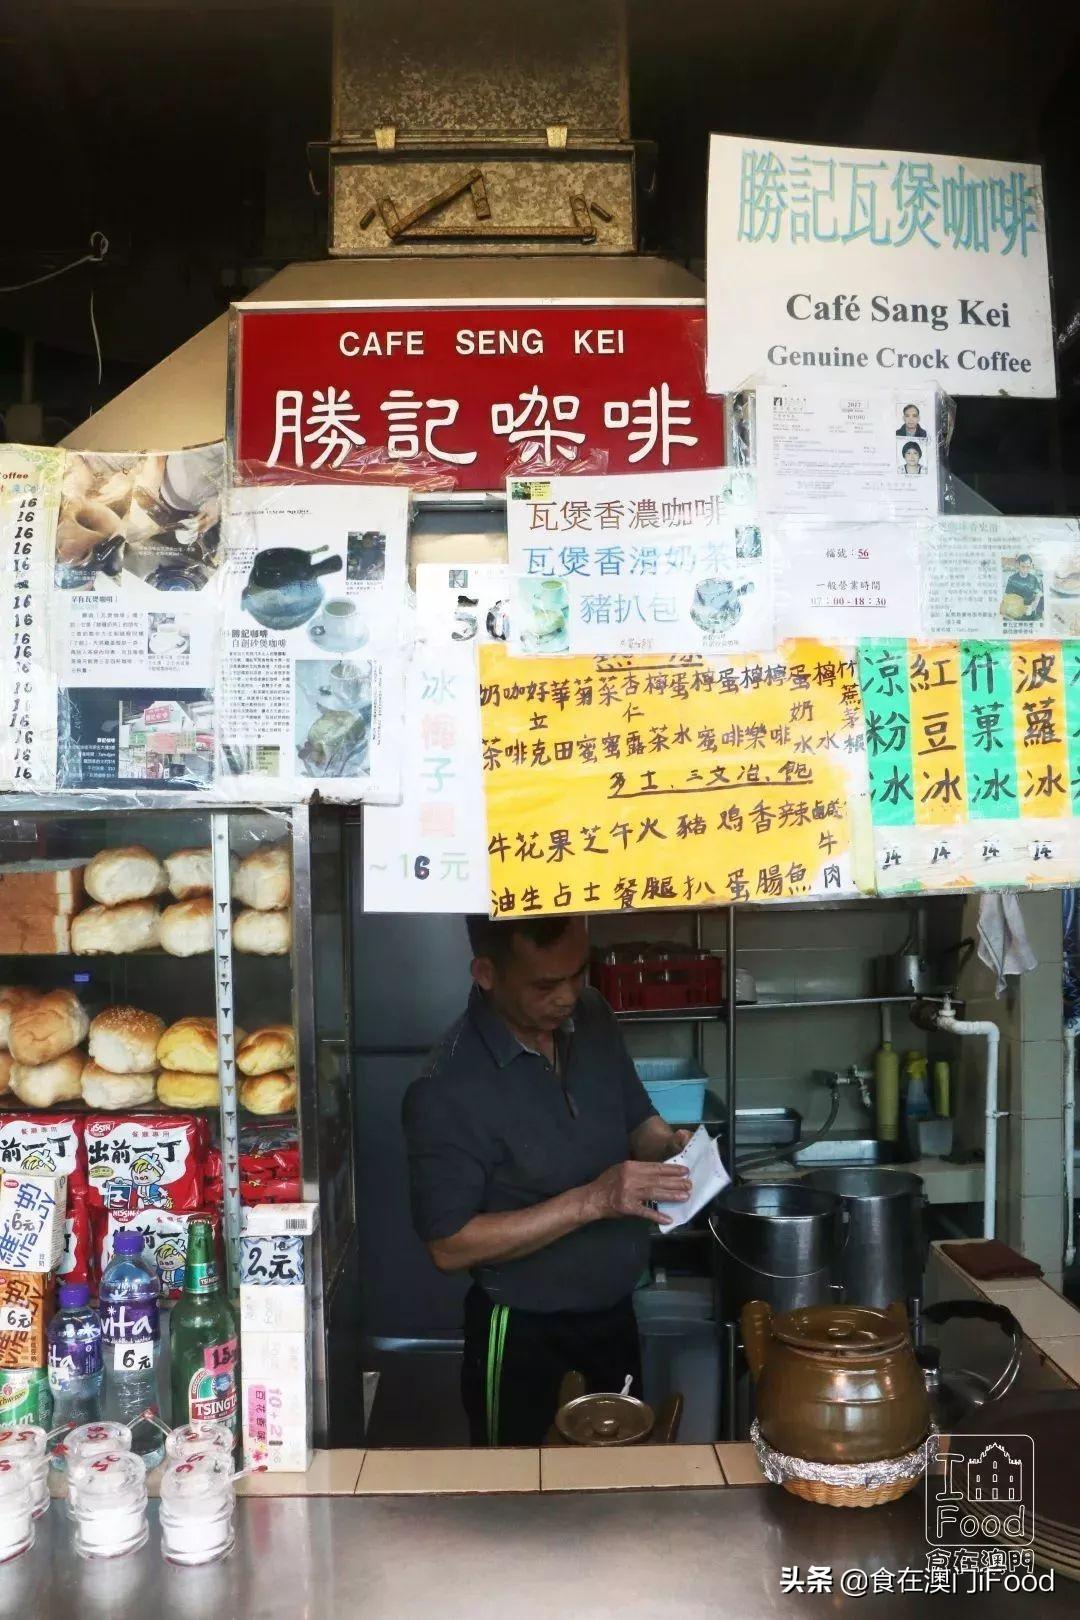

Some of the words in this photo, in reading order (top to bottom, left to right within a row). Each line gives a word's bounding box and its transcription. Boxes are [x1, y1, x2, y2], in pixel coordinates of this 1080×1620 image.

[737, 150, 1038, 257] 勝記瓦煲咖啡
[786, 293, 861, 321] Café
[872, 295, 948, 331] Sang
[958, 298, 1011, 328] Kei
[339, 331, 425, 356] CAFE
[455, 329, 545, 355] SENG
[574, 329, 625, 354] KEI
[767, 345, 869, 367] Genuine
[876, 347, 950, 369] Crock
[957, 349, 1032, 373] Coffee
[14, 526, 34, 540] 16
[13, 542, 33, 556] 16
[13, 595, 32, 609] 16
[14, 614, 33, 627] 16
[14, 645, 32, 659] 16
[910, 653, 962, 804] 紅豆冰
[14, 767, 32, 779] 16
[88, 1138, 182, 1165] 出前一丁
[248, 1246, 297, 1280] 2元
[7, 1310, 31, 1329] 6元
[100, 1305, 152, 1338] vita
[122, 1349, 151, 1370] 6元
